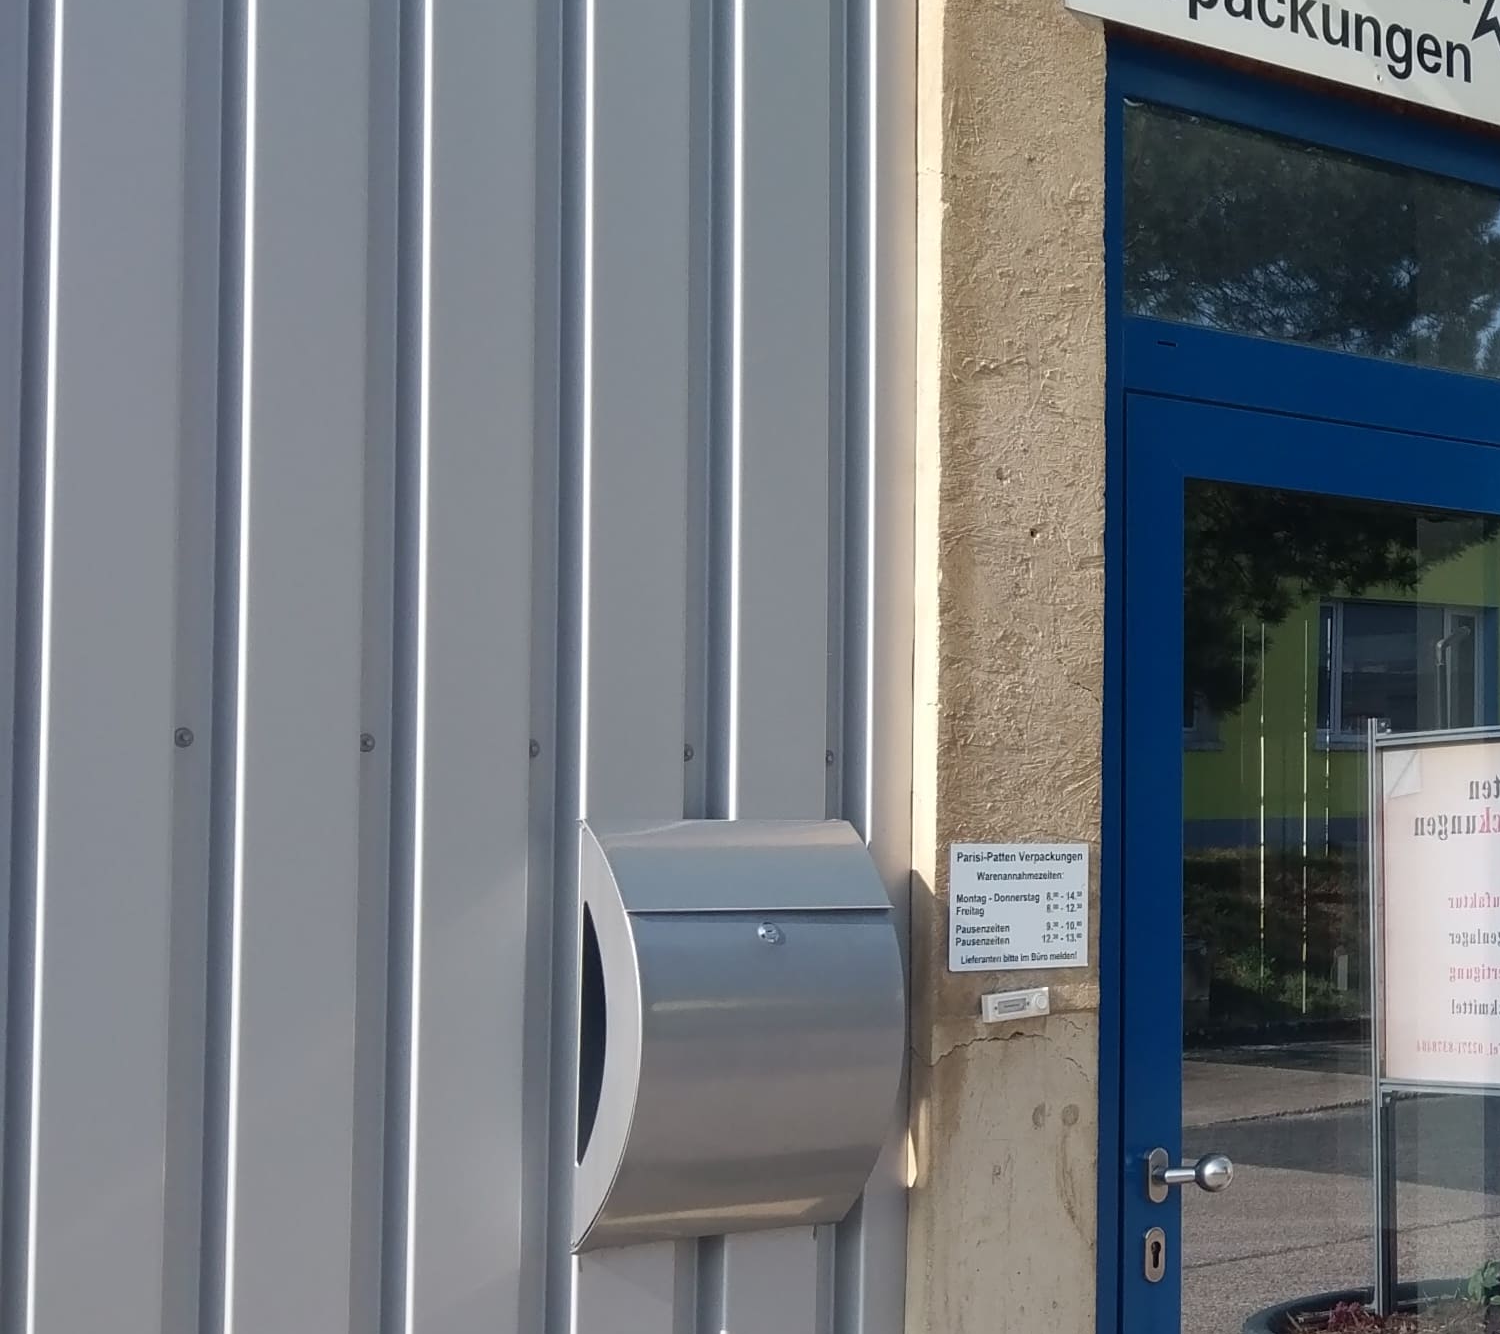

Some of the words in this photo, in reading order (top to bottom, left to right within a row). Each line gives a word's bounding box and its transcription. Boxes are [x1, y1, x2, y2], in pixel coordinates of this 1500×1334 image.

[957, 852, 1016, 862] Parisi-Patten
[1019, 851, 1083, 864] Verpackungen
[956, 894, 987, 905] Montag
[994, 893, 1040, 903] Donnerstag
[956, 906, 985, 917] Freitag
[956, 924, 1010, 934] Pausenzeiten
[955, 937, 1010, 947] Pausenzeiten
[960, 955, 1001, 965] Lieferanten
[1003, 953, 1019, 963] bitte
[1020, 953, 1029, 962] im
[1031, 951, 1048, 961] Büro
[1049, 951, 1078, 960] melden!
